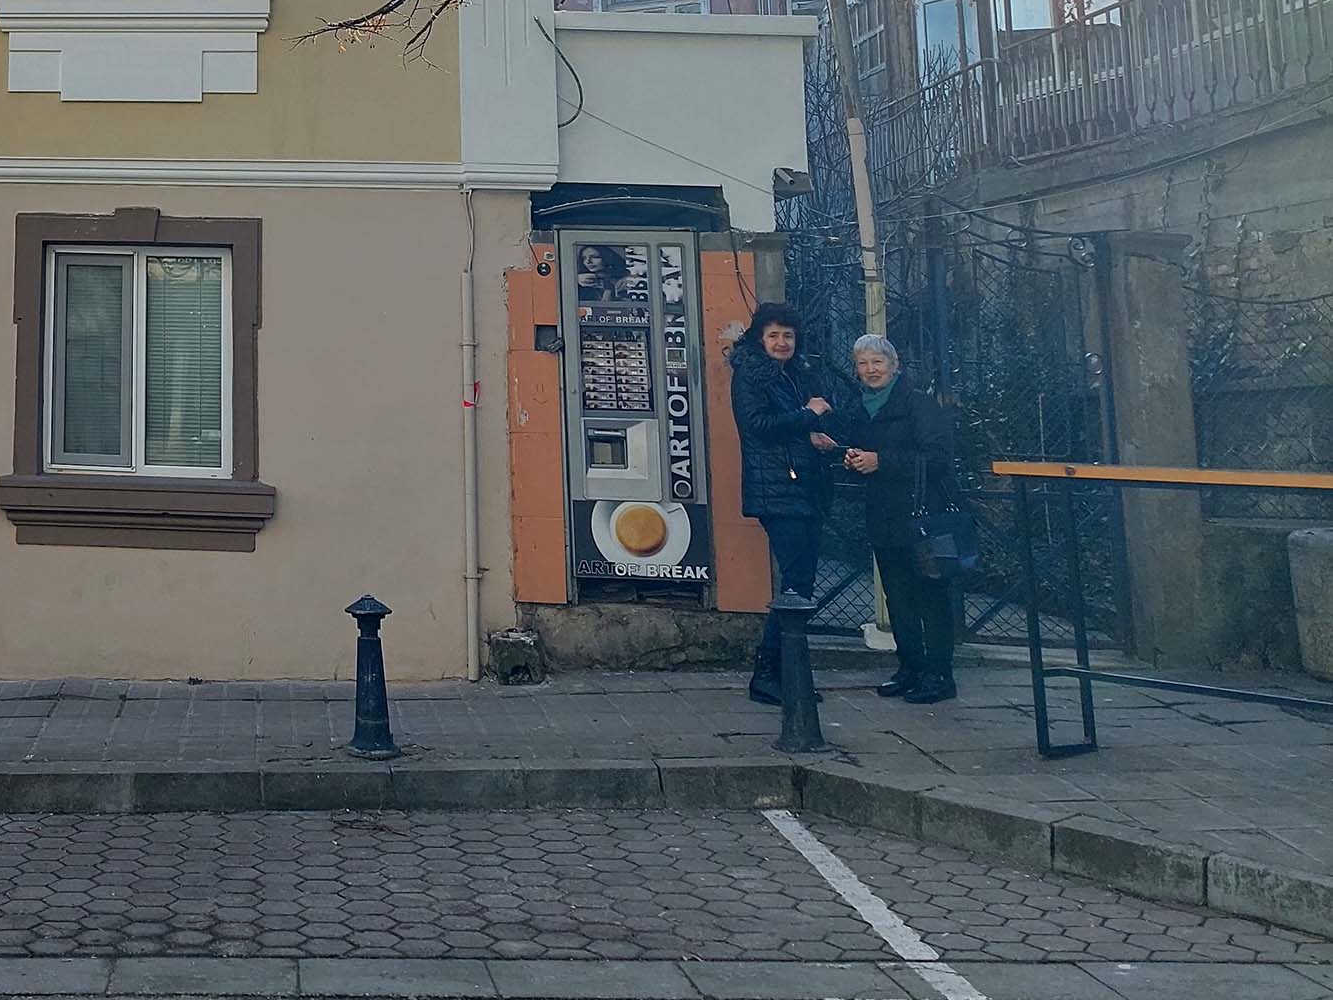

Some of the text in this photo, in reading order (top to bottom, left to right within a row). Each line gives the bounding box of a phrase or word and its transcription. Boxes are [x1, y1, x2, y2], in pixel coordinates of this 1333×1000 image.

[599, 315, 611, 323] OF
[615, 316, 649, 324] BREAK
[647, 564, 709, 580] BREAK
